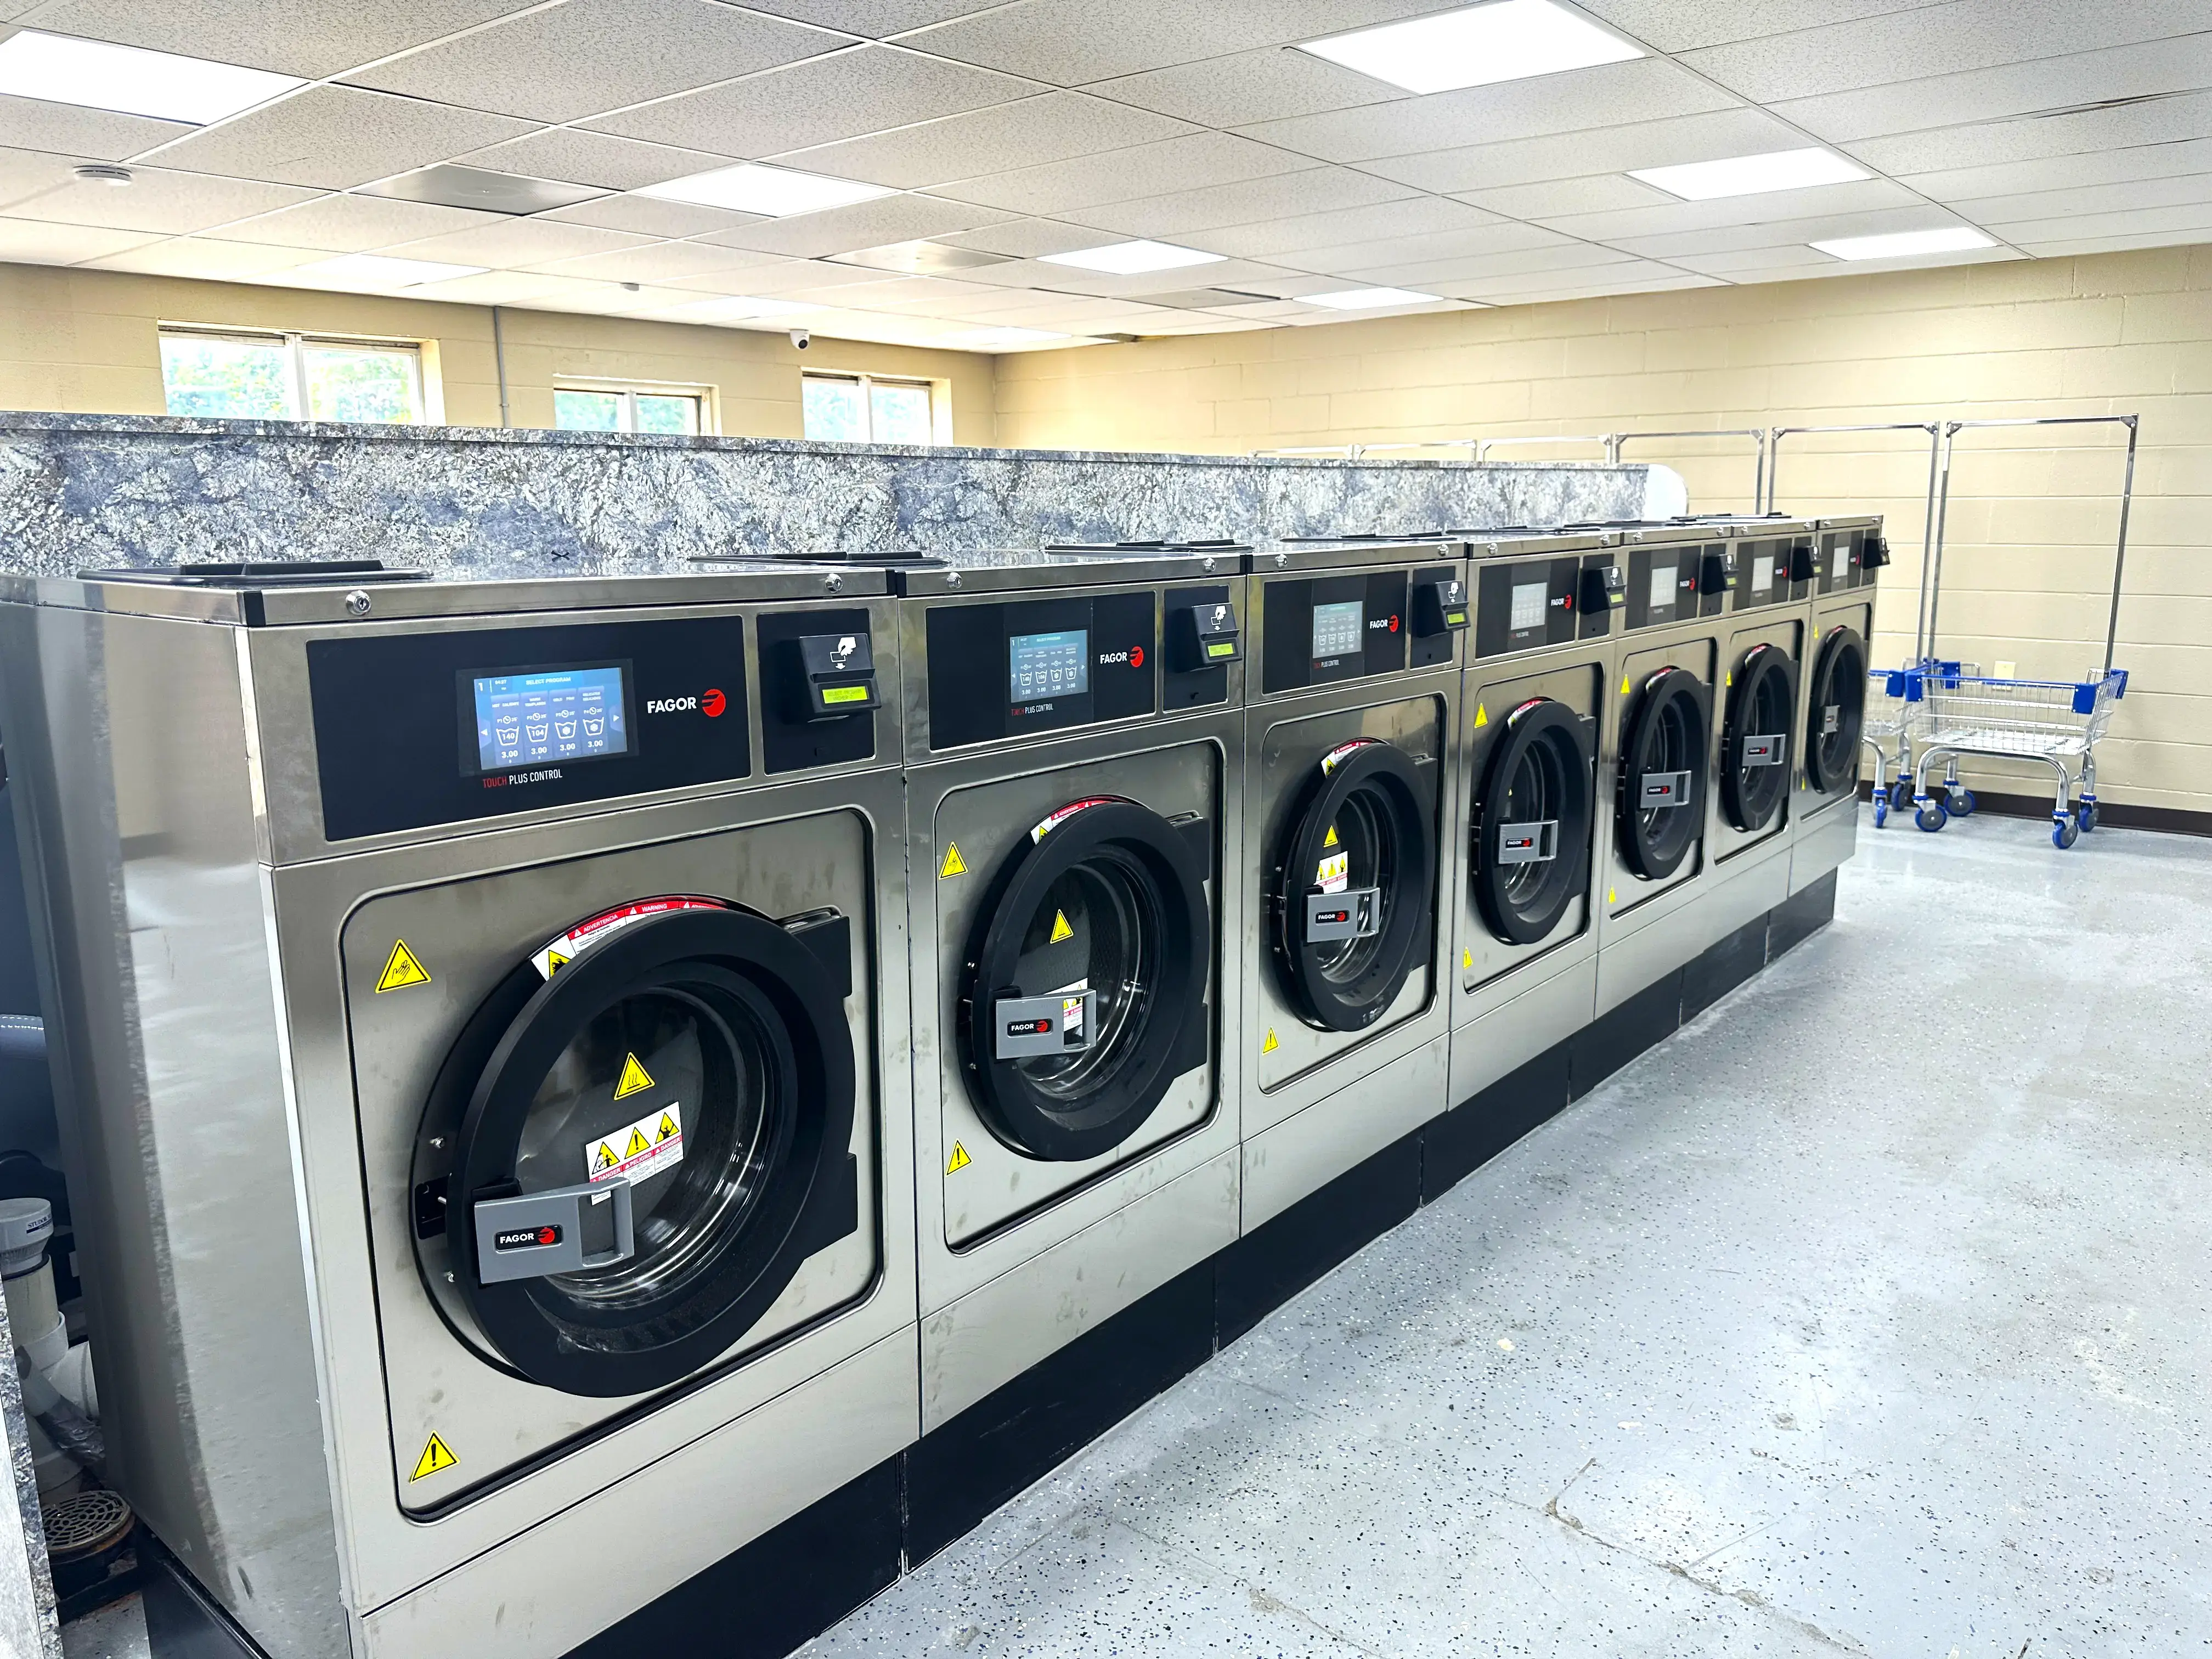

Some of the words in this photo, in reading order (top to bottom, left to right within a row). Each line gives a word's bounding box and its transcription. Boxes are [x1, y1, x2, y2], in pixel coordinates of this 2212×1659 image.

[1370, 619, 1387, 629] FAGOR
[1100, 652, 1127, 664] FAGOR
[478, 682, 483, 691] 1
[647, 697, 697, 713] FAGOR
[1025, 706, 1035, 714] PLUS
[1036, 703, 1054, 712] CONTROL
[560, 743, 575, 751] 3.00
[483, 776, 507, 788] TOUCH
[509, 774, 528, 785] PLUS
[529, 769, 563, 782] CONTROL
[641, 903, 667, 912] WARNING
[583, 914, 618, 933] ADVERTENCIA
[1011, 1023, 1034, 1031] FAGOR
[661, 1137, 681, 1150] DANGER
[630, 1152, 652, 1167] PELIGRO
[598, 1167, 621, 1181] DANGER
[500, 1233, 534, 1244] FAGOR
